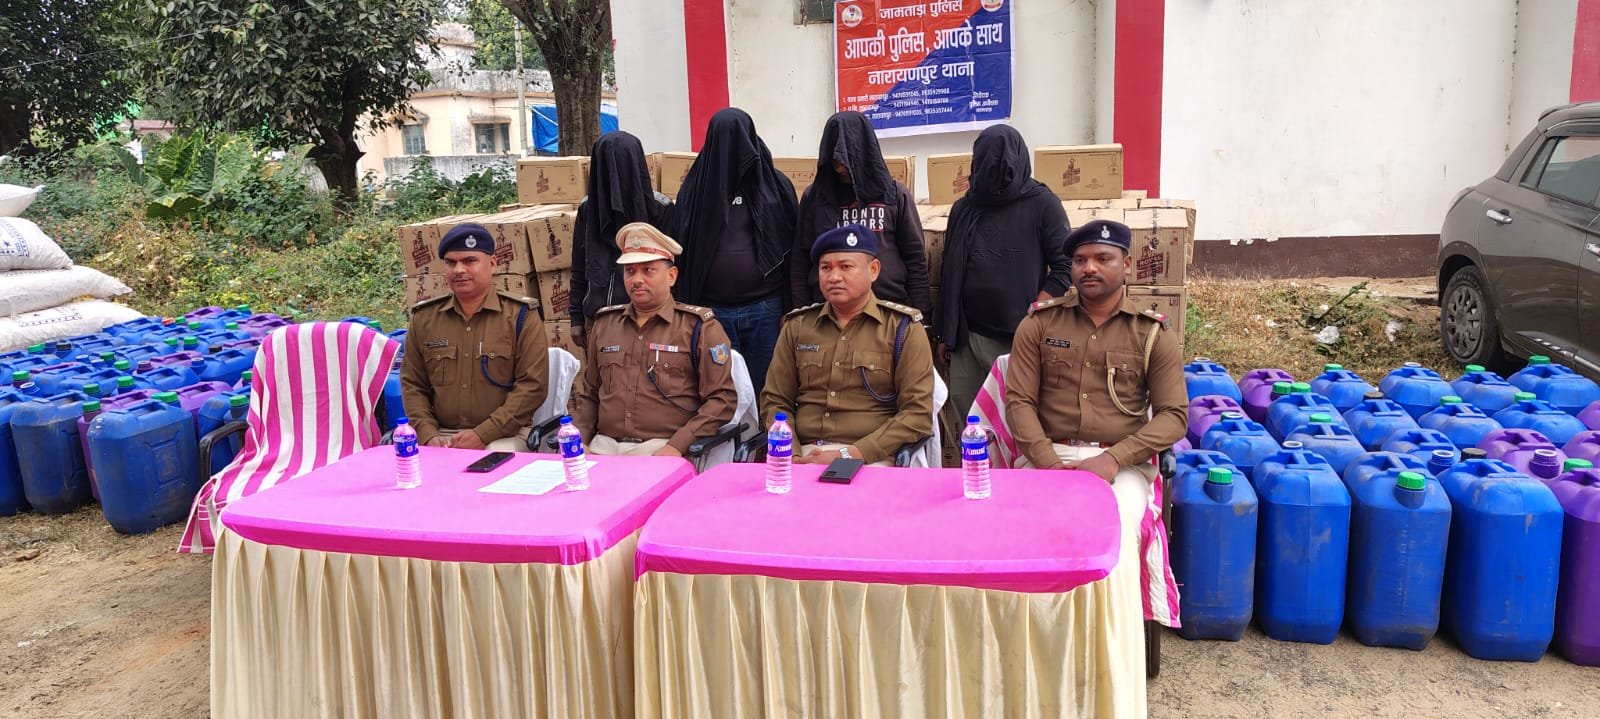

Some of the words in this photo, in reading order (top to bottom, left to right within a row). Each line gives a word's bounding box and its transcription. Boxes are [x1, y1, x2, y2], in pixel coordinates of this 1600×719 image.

[879, 4, 926, 19] जामताड़ा
[929, 0, 963, 17] पुलिस
[845, 30, 885, 59] आपकी
[888, 27, 930, 61] पुलिस,
[933, 19, 973, 50] आपके
[975, 22, 1003, 47] साथ
[868, 65, 937, 84] नारायणपुर
[942, 61, 975, 78] थाना
[842, 207, 885, 220] RONTO
